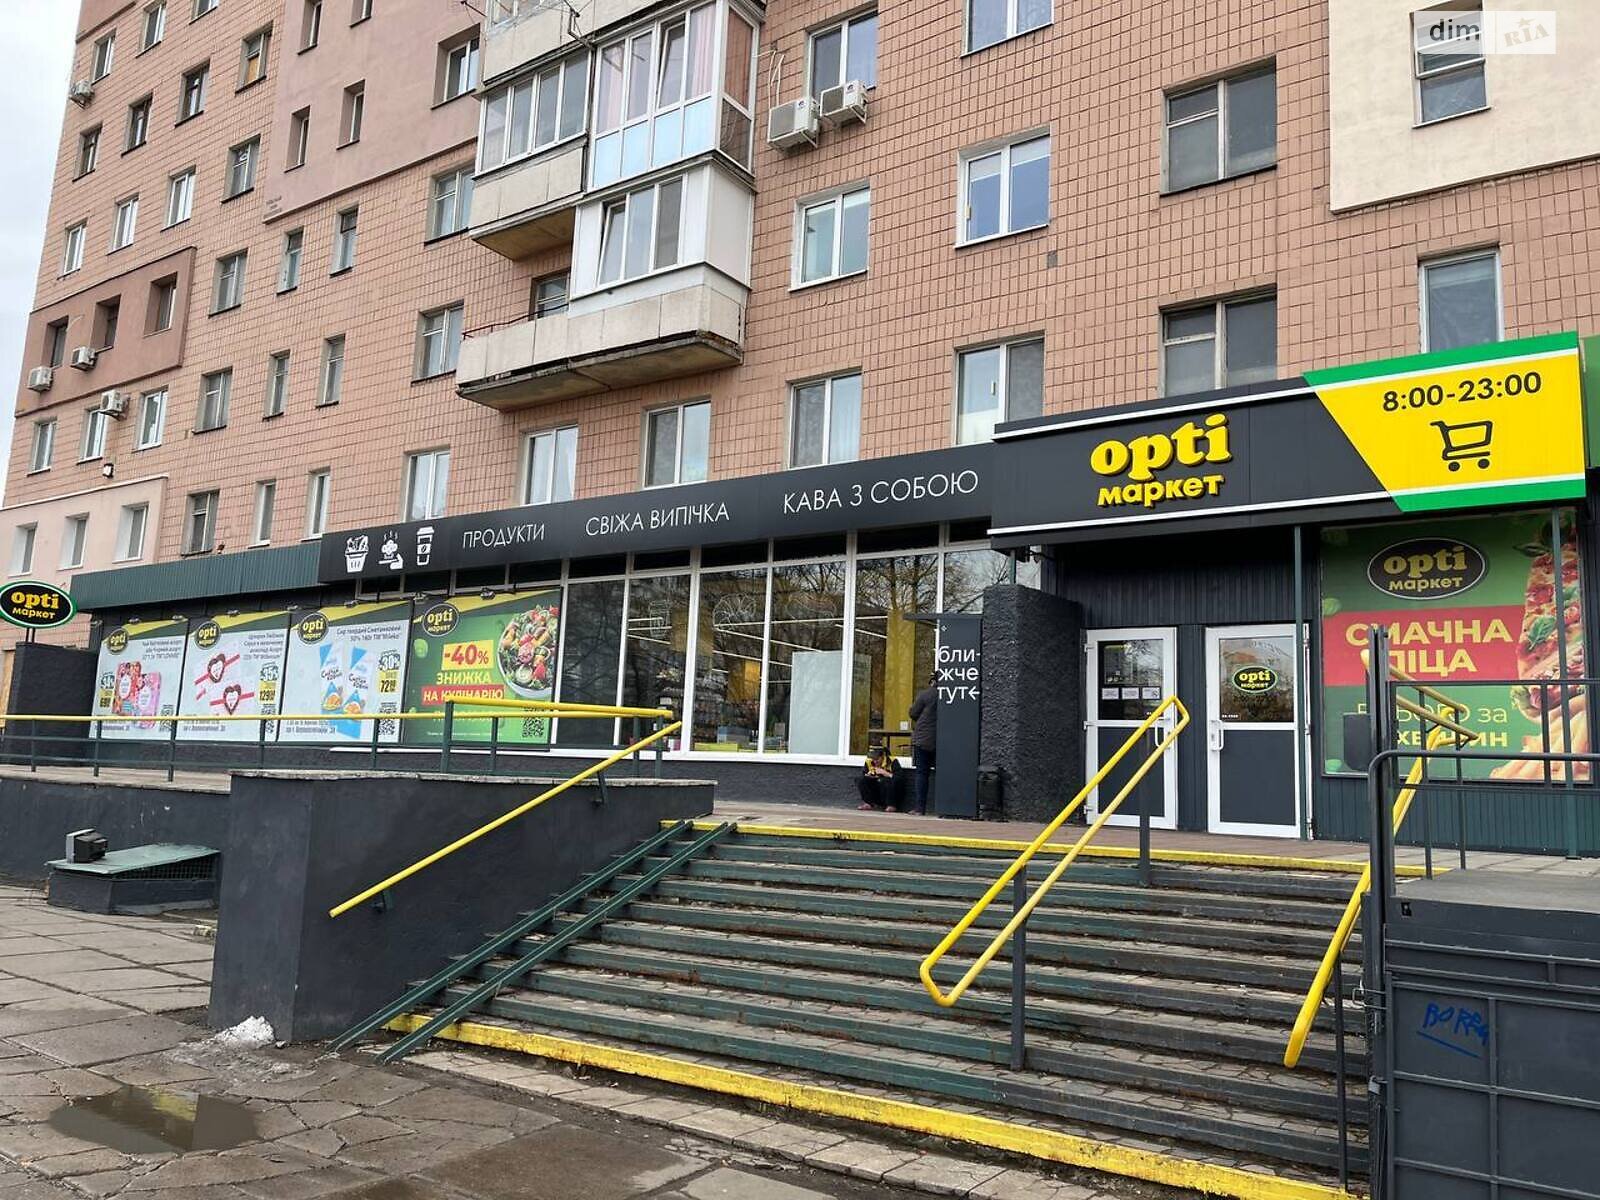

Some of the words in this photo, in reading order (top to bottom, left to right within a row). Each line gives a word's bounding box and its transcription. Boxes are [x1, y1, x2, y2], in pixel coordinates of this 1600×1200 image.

[1383, 372, 1542, 412] 8:00-23:00
[1090, 413, 1232, 482] opti
[783, 487, 843, 515] КАВА
[870, 470, 979, 504] СОБОЮ
[1097, 474, 1225, 508] маркет
[586, 511, 645, 537] СВІЖА
[650, 502, 731, 530] ВИПІЧКА
[462, 523, 545, 549] ПРОДУКТИ
[1383, 545, 1468, 578] opti
[1388, 576, 1464, 593] маркет
[11, 592, 60, 610] opti
[12, 607, 56, 619] маркет
[427, 608, 453, 626] opti
[302, 618, 324, 633] opti
[444, 644, 490, 666] -40%
[938, 646, 981, 663] бли-
[436, 671, 492, 686] ЗНИЖКА
[938, 667, 979, 681] жче
[1239, 669, 1271, 683] opti
[423, 690, 438, 702] НА
[937, 686, 968, 704] тут
[1478, 705, 1509, 723] за
